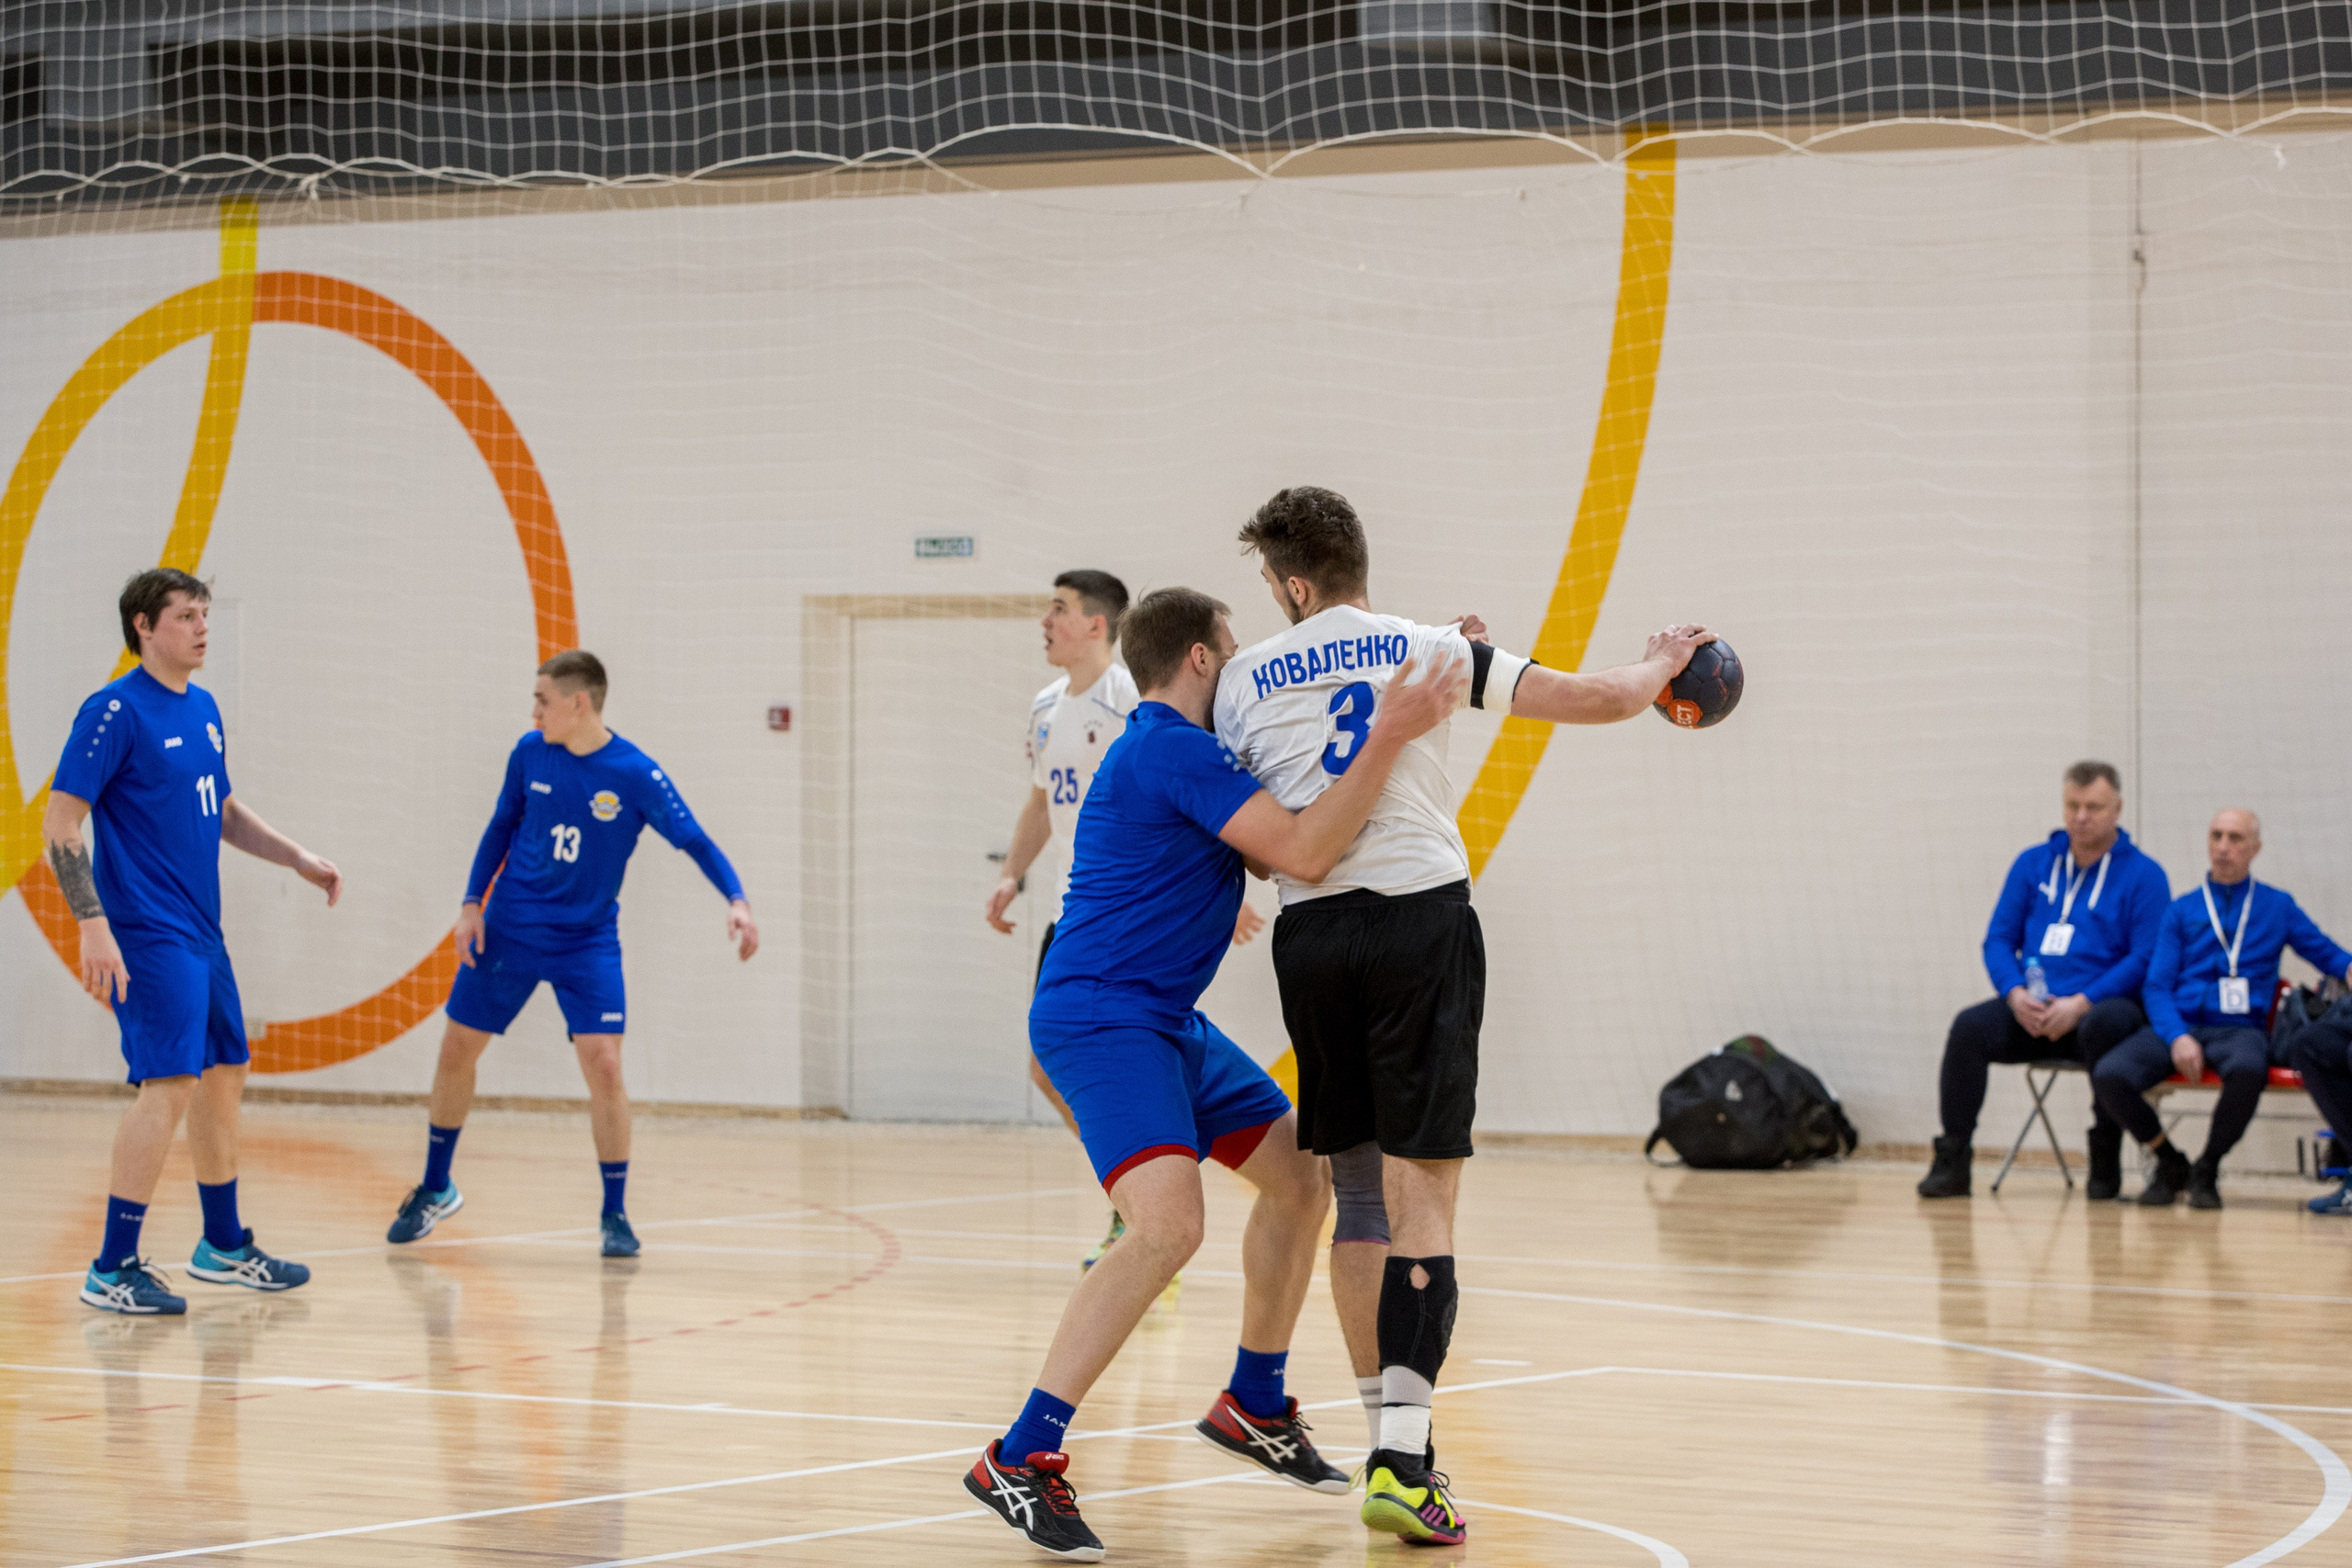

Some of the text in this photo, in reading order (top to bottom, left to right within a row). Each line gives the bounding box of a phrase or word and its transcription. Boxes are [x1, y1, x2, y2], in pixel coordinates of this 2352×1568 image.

[1252, 635, 1408, 700] КОВАЛЕНКО
[1321, 682, 1375, 775] 3
[196, 773, 218, 817] 11
[1050, 768, 1079, 805] 25
[550, 823, 582, 863] 13
[1043, 1414, 1068, 1429] JAK
